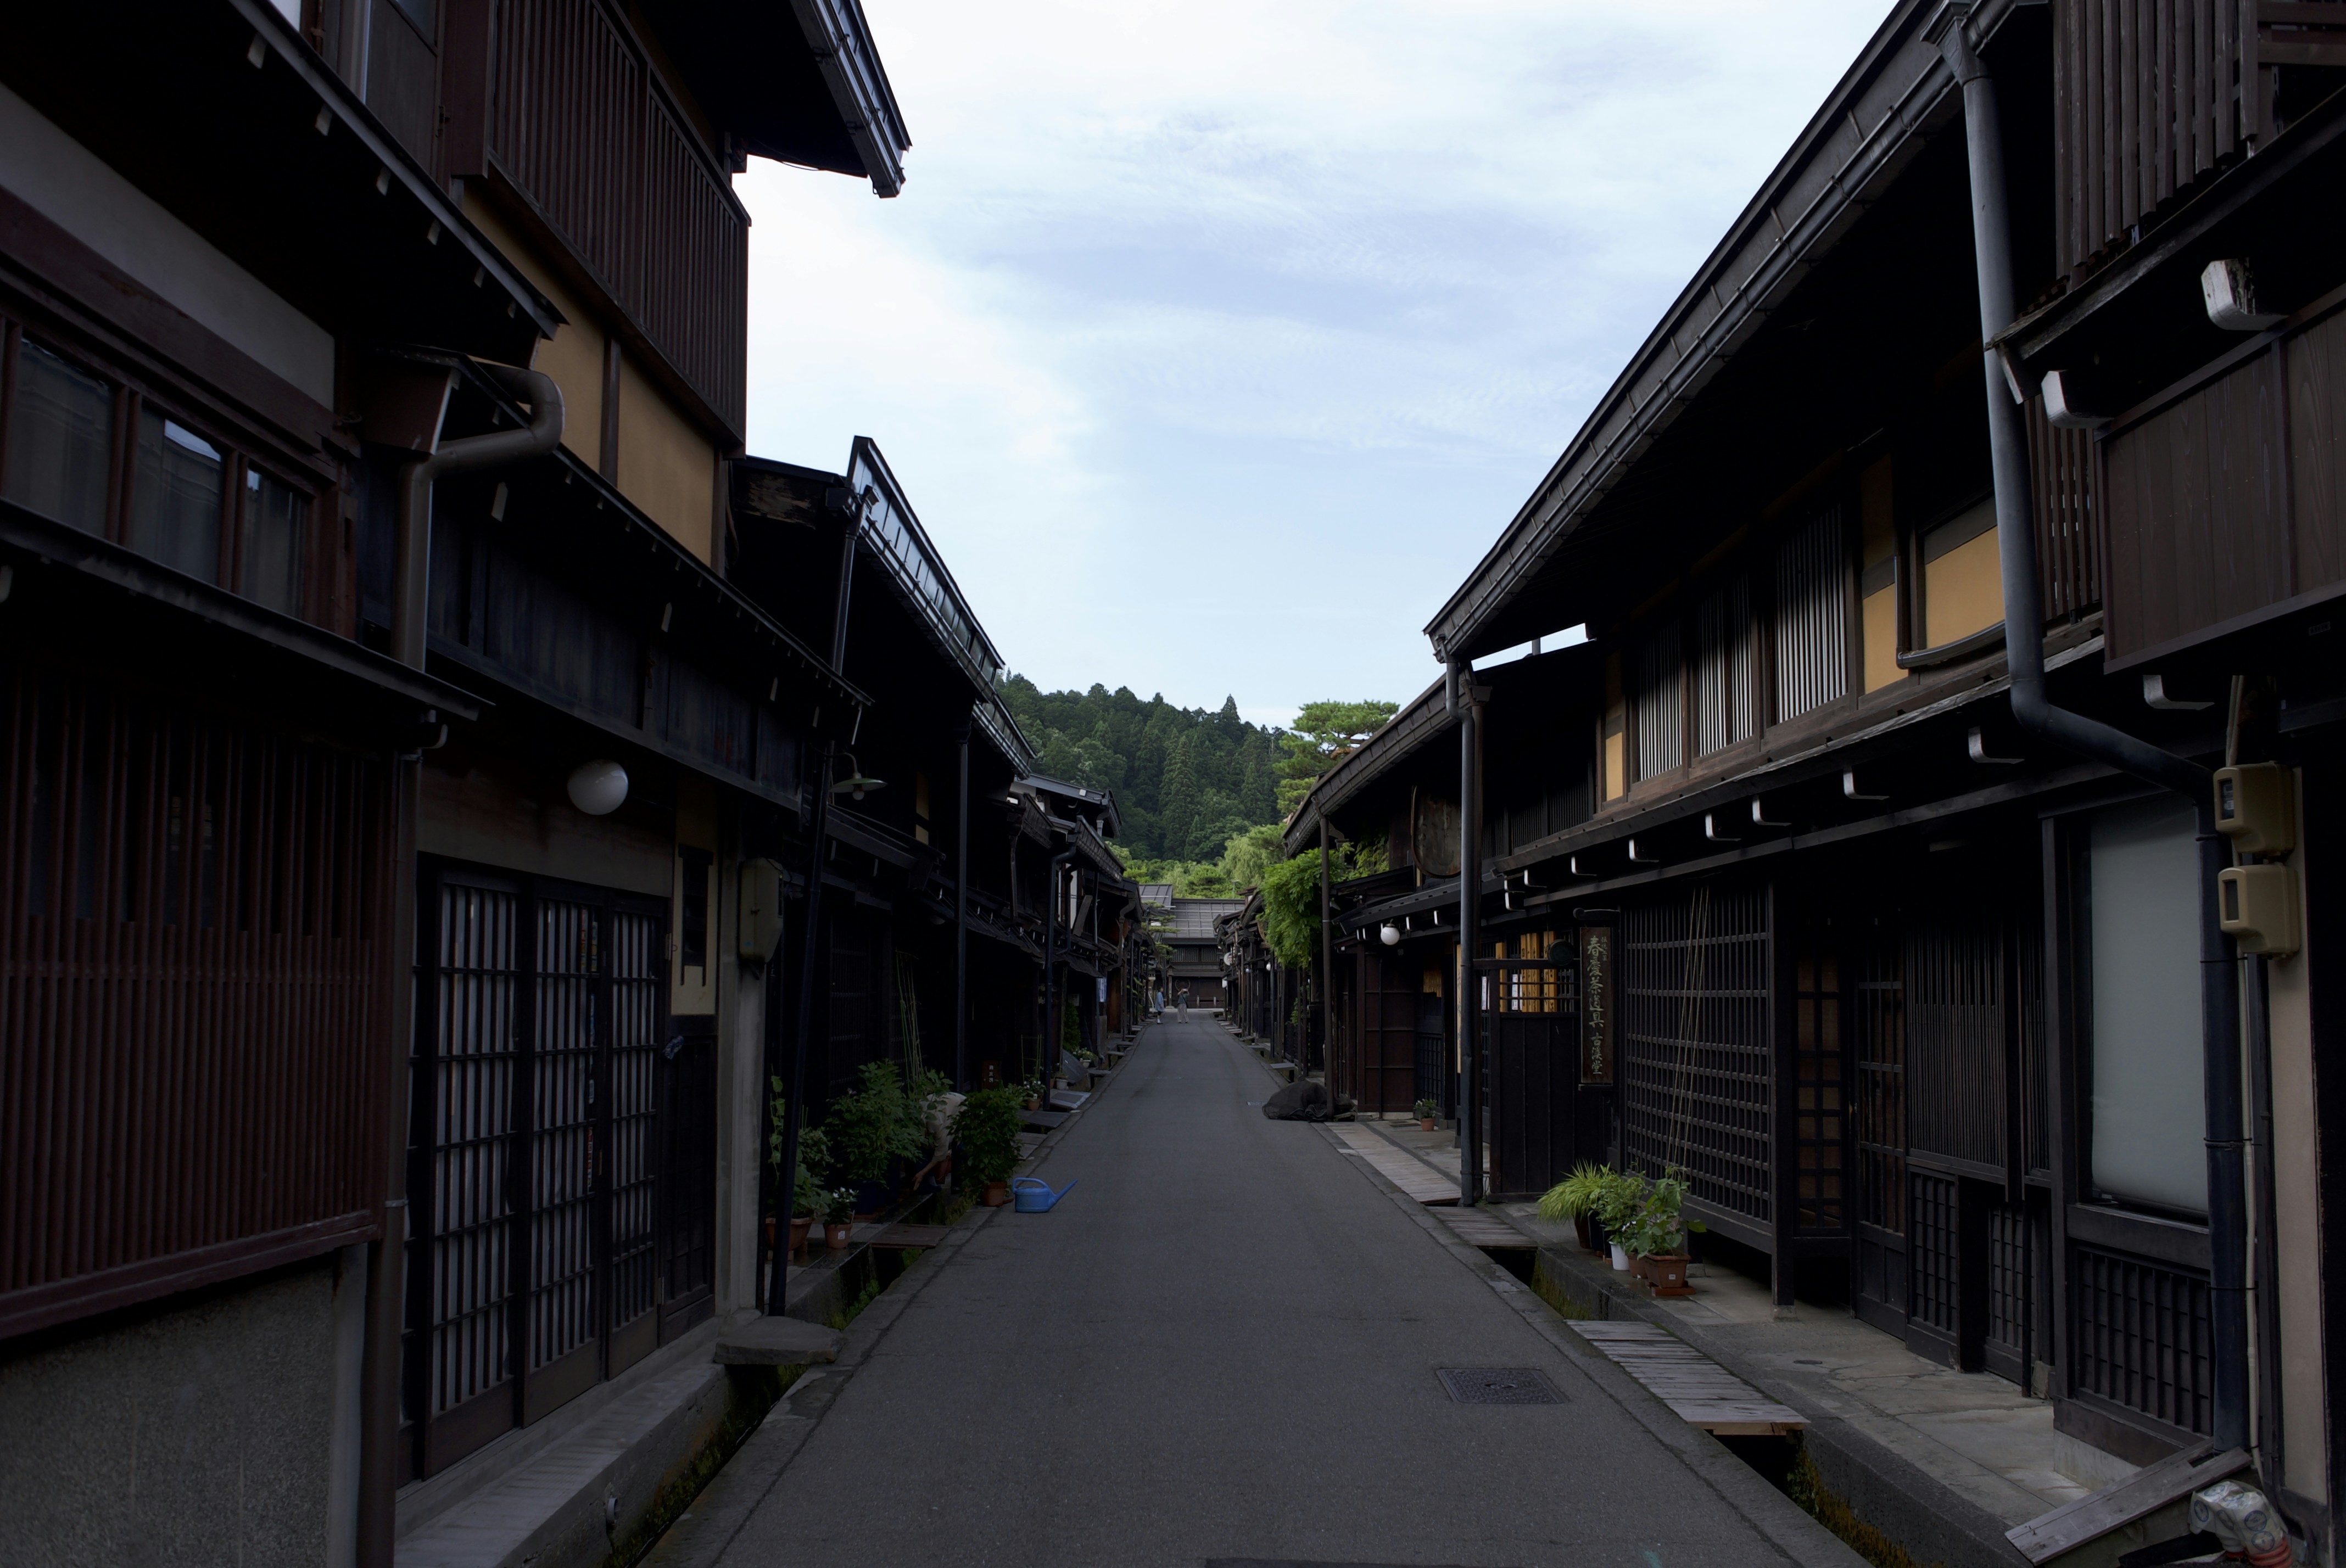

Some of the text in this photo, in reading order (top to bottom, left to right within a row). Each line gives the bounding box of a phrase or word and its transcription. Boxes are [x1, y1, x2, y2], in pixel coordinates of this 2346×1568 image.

[1587, 935, 1605, 1028] 春慶茶道具
